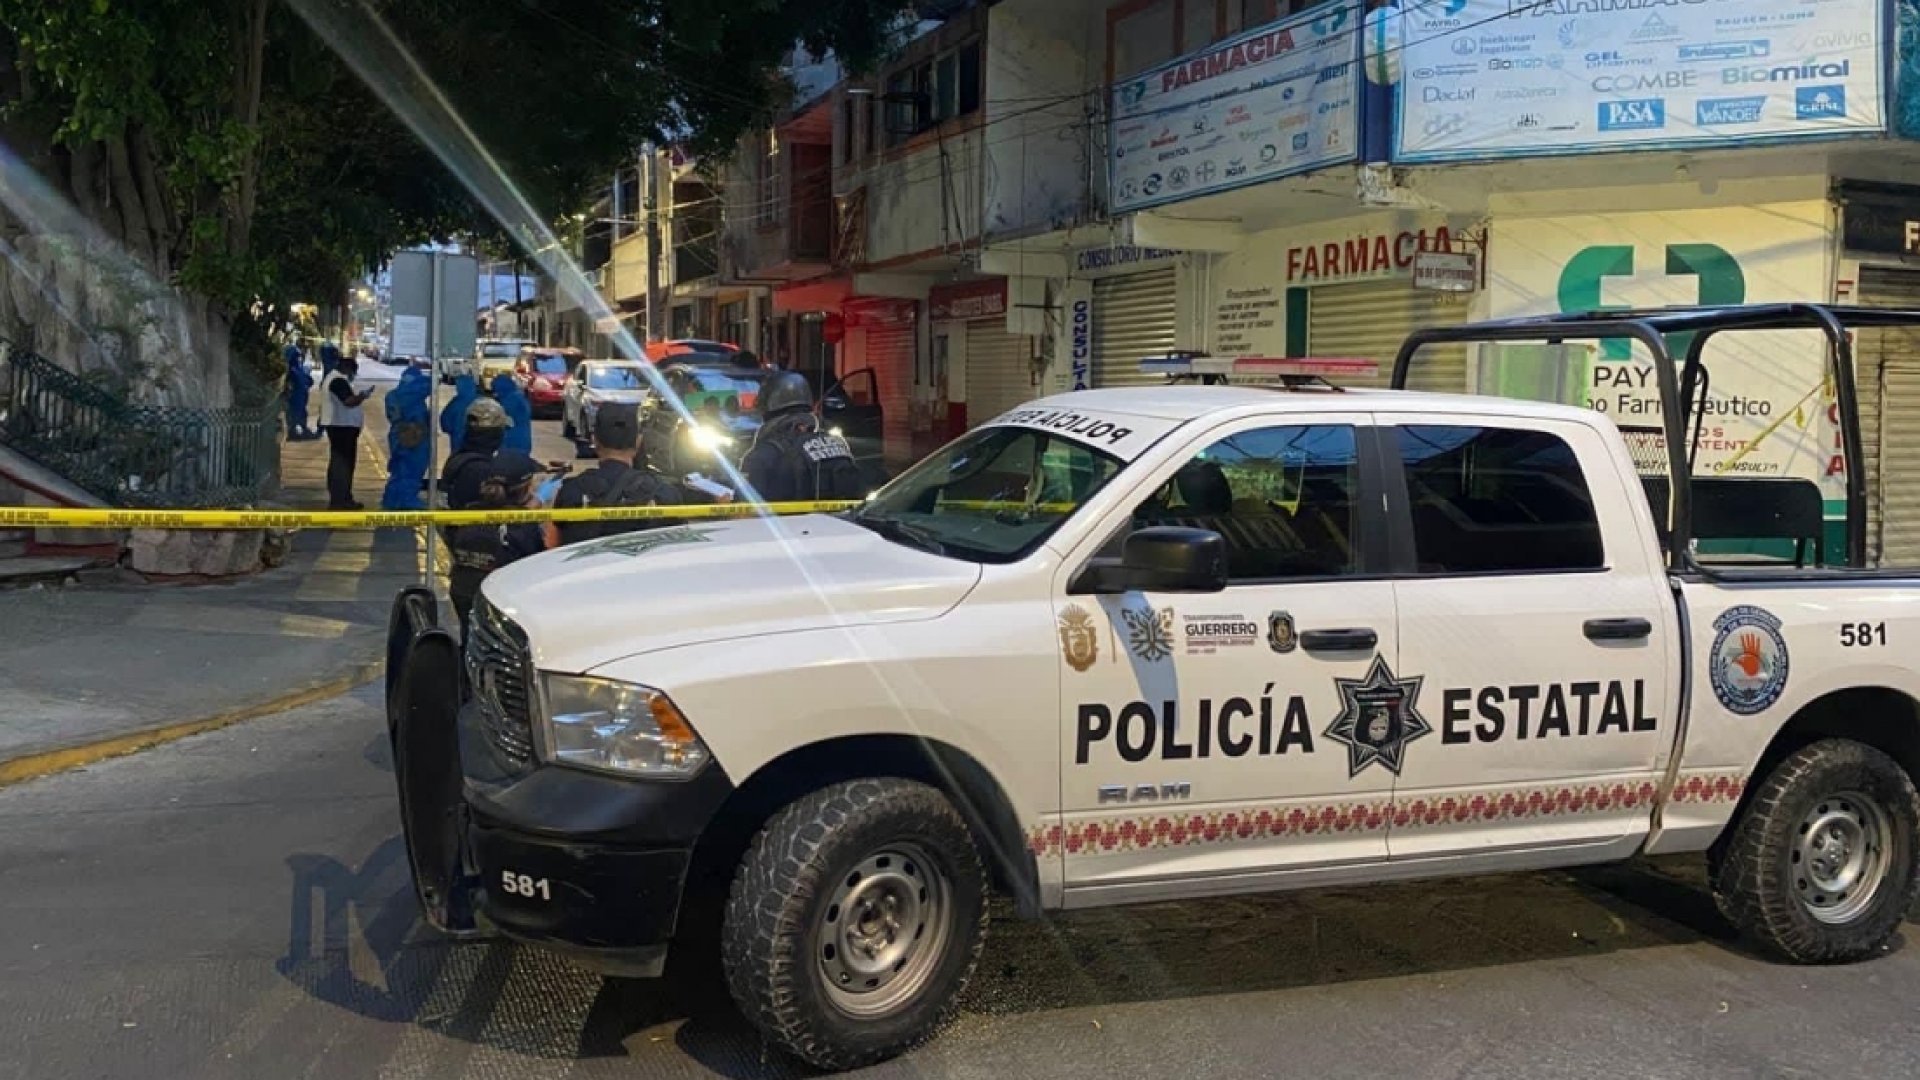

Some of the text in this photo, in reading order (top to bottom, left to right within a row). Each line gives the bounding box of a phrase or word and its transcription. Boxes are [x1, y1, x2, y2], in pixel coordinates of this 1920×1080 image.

[1162, 28, 1295, 93] FARMACIA
[1721, 59, 1850, 85] Biomiral
[1592, 70, 1698, 93] COMBE
[1287, 226, 1452, 281] FARMACIA
[1185, 623, 1258, 636] GUERRERO
[1839, 621, 1888, 648] 581
[1075, 678, 1658, 765] POLICÍA ESTATAL
[1097, 782, 1192, 804] RAM
[501, 870, 551, 900] 581
